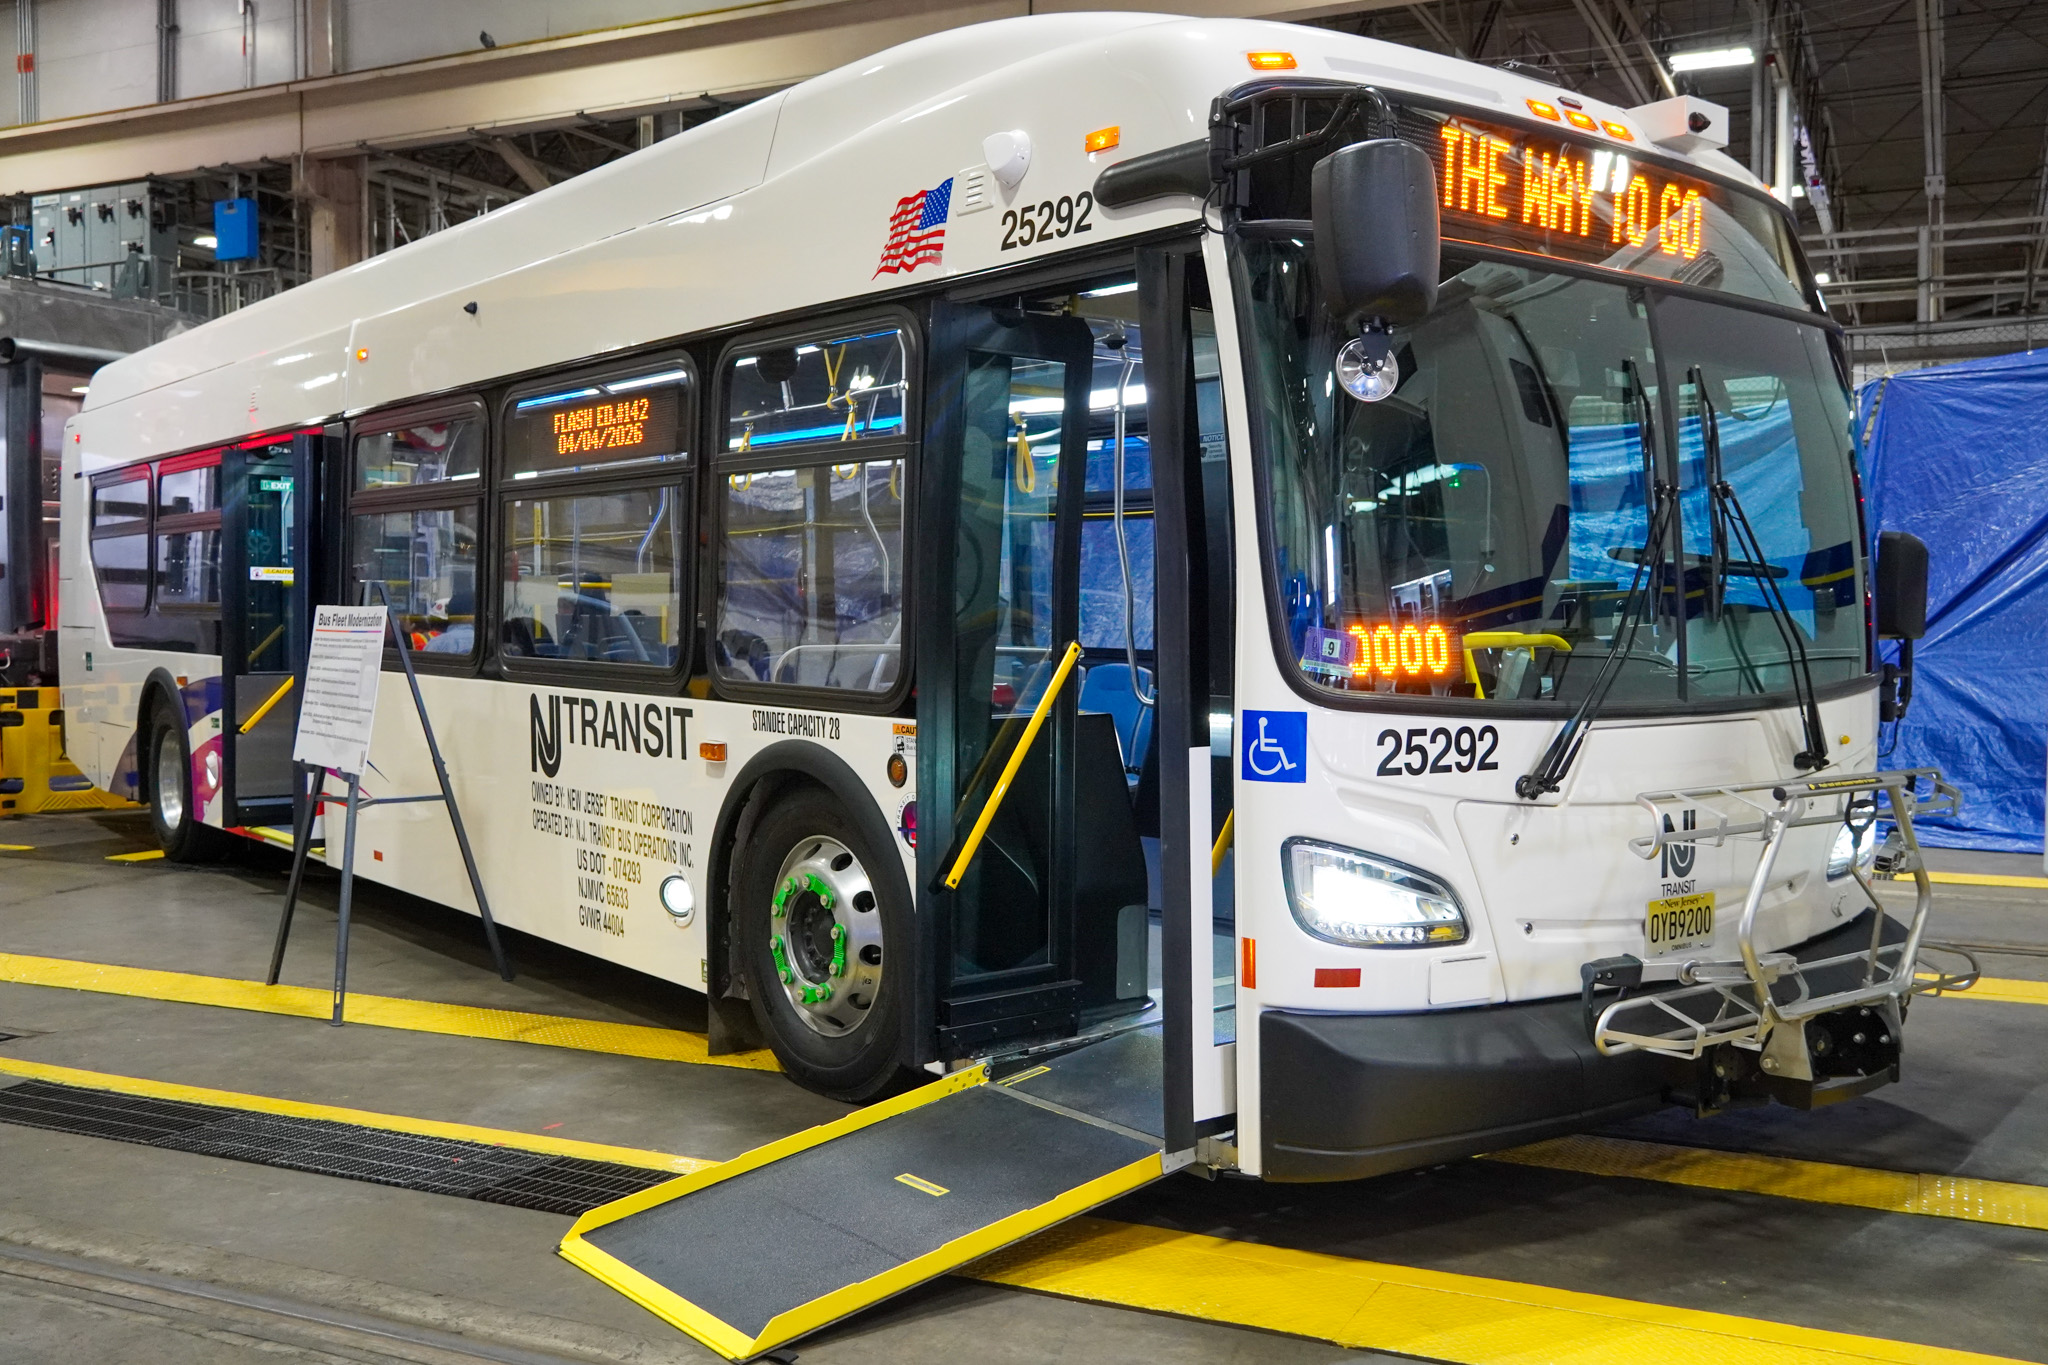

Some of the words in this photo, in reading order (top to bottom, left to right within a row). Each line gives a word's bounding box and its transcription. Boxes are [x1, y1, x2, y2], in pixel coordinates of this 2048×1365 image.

[1441, 126, 1510, 218] THE
[1522, 147, 1596, 236] WAY
[1659, 183, 1702, 259] GO
[1000, 190, 1094, 252] 25292
[553, 408, 593, 434] FLASH
[1202, 433, 1225, 442] NOTICE
[558, 422, 644, 455] 04/04/2026
[270, 481, 291, 490] EXIT
[318, 613, 331, 626] Bus
[331, 613, 348, 627] Fleet
[347, 612, 383, 627] Modernization
[1327, 641, 1335, 656] 9
[562, 695, 694, 761] TRANSIT
[752, 709, 786, 735] STANDEE
[787, 712, 827, 740] CAPACITY
[829, 717, 841, 741] 28
[1376, 724, 1499, 777] 25292
[531, 780, 554, 806] OWNED
[555, 785, 566, 809] BY:
[567, 788, 582, 812] NEW
[583, 791, 608, 818] JERSEY
[609, 795, 639, 825] TRANSIT
[641, 802, 693, 836] CORPORATION
[532, 808, 563, 837] OPERATED
[564, 815, 575, 839] BY:
[576, 819, 588, 843] N.J.
[589, 821, 615, 850] TRANSIT
[617, 827, 632, 854] BUS
[633, 831, 678, 865] OPERATIONS
[679, 841, 695, 869] INC.
[576, 847, 588, 872] US
[589, 850, 607, 876] DOT
[612, 856, 642, 885] 074293
[577, 875, 605, 904] NJMVC
[606, 883, 629, 911] 65633
[1661, 879, 1697, 898] TRANSIT
[1664, 898, 1679, 909] New
[1679, 896, 1700, 909] Jersey
[578, 904, 602, 932] GVWR
[602, 911, 625, 939] 44004
[1671, 941, 1693, 952] OMNIBUS
